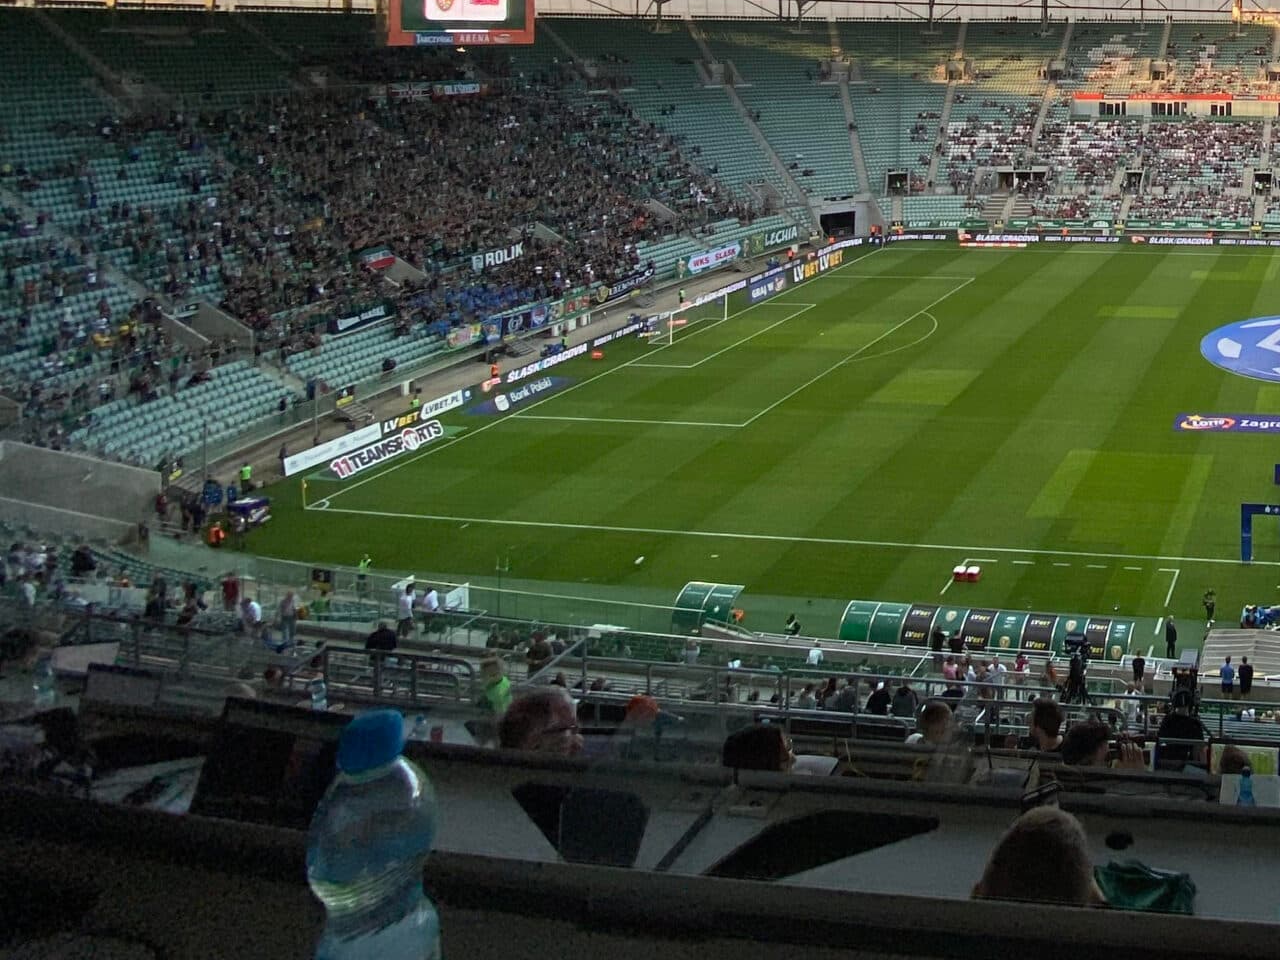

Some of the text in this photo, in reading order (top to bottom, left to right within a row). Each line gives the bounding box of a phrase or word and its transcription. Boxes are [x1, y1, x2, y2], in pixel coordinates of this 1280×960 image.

[764, 225, 798, 247] LECHIA
[486, 242, 524, 267] ROLIK
[693, 257, 709, 268] WKS
[509, 377, 552, 403] Bank Polski
[424, 395, 460, 415] LVBET.PL
